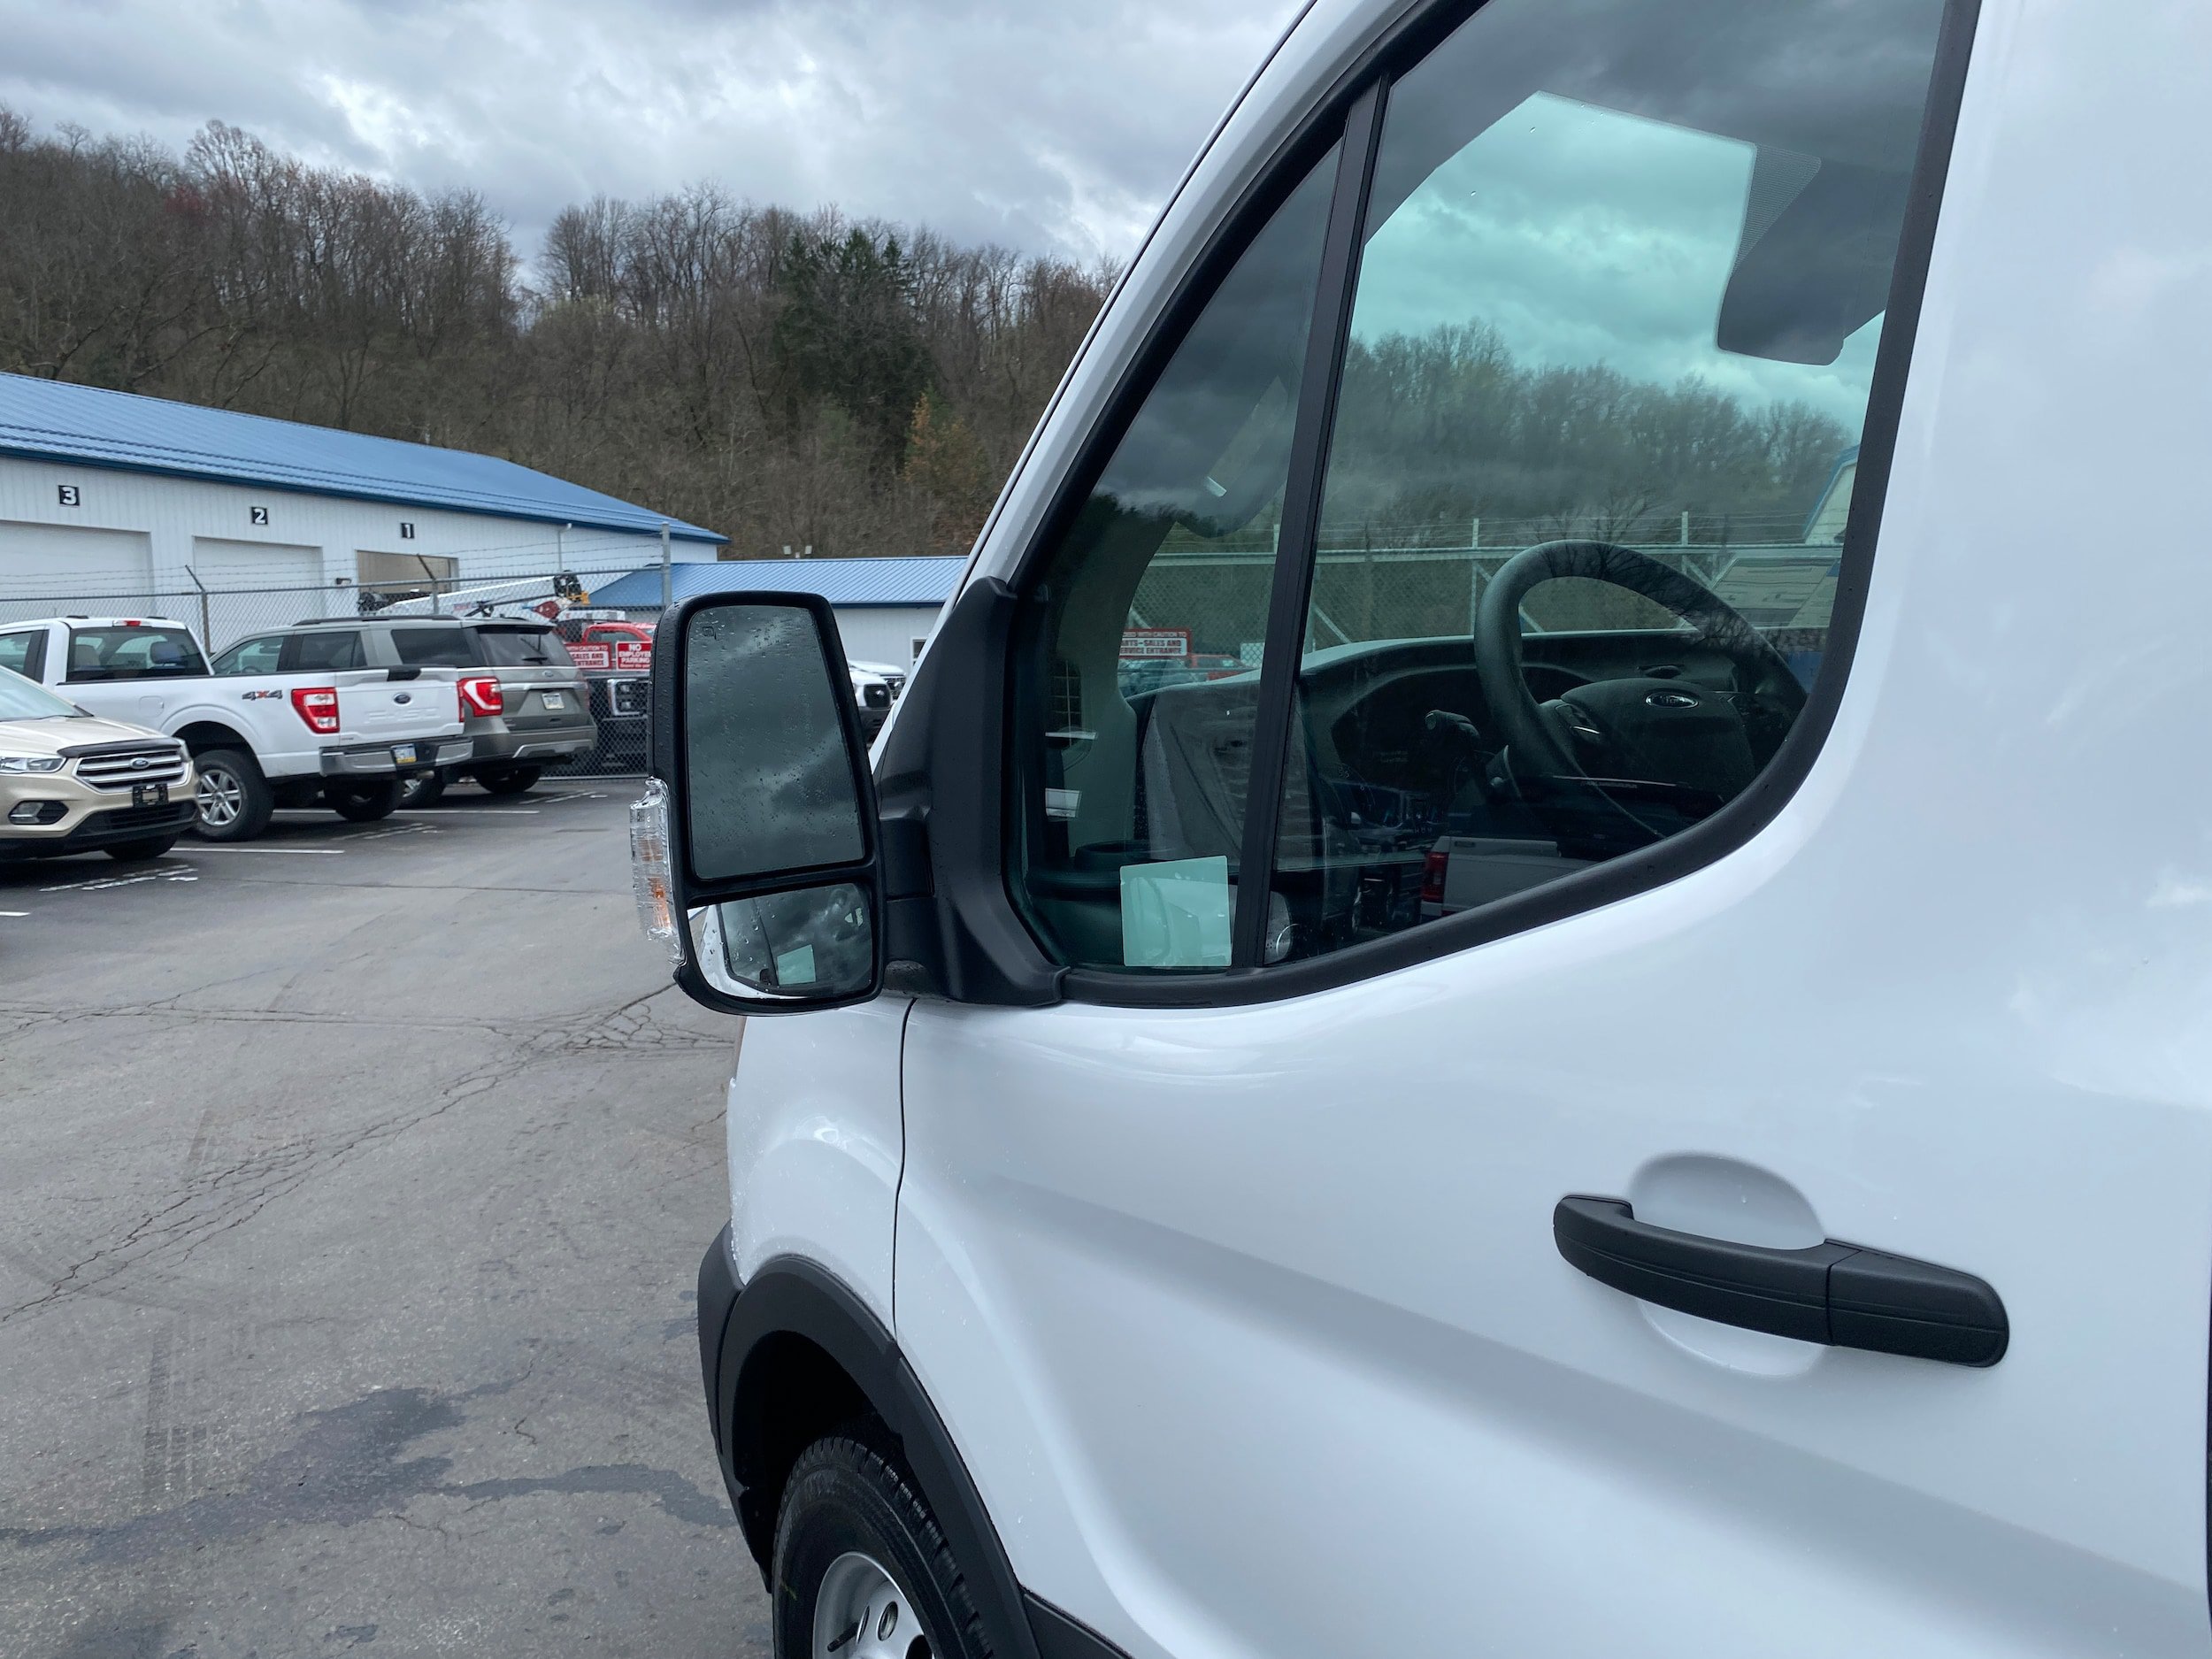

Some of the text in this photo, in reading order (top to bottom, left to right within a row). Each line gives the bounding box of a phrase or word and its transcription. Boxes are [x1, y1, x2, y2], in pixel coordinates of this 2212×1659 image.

[62, 486, 77, 505] 3
[254, 508, 266, 525] 2
[404, 524, 411, 539] 1
